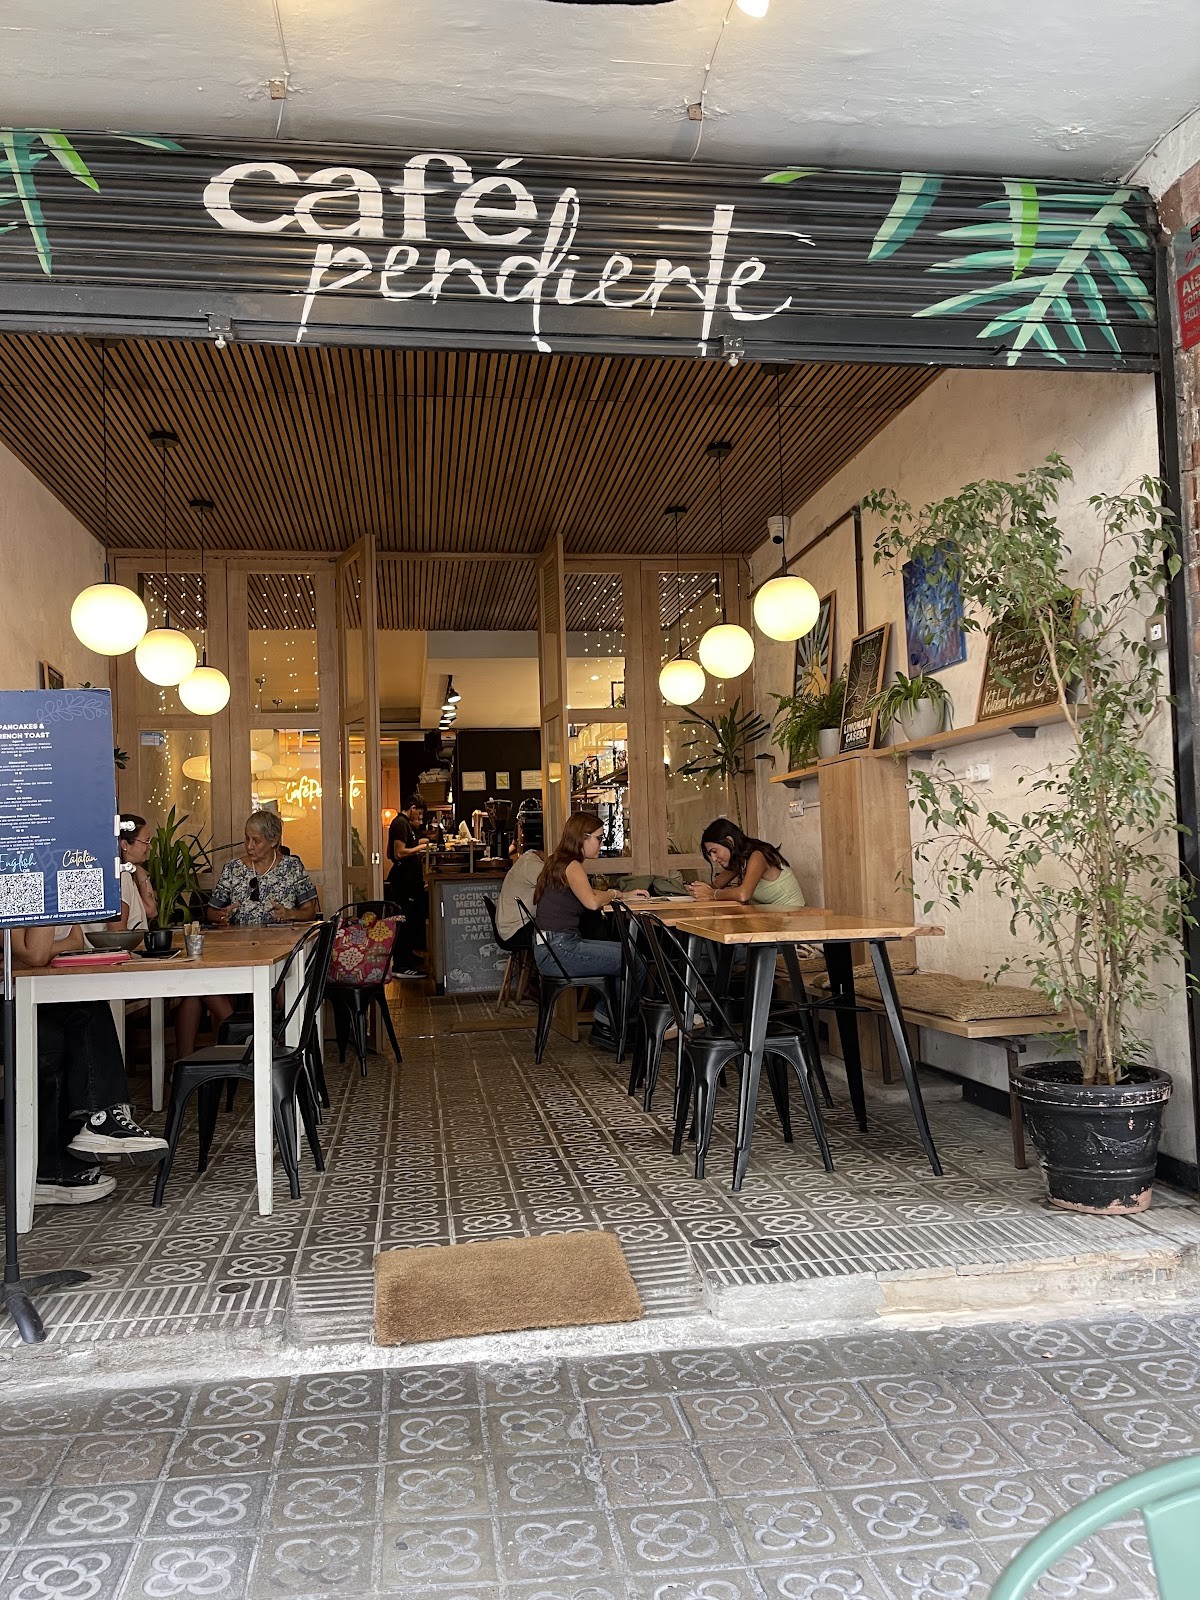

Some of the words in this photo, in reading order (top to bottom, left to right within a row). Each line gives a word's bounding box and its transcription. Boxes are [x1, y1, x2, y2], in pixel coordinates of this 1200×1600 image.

[203, 154, 538, 244] café
[291, 187, 816, 357] pendiente
[845, 728, 867, 743] CASERA
[459, 908, 490, 916] BRUN
[451, 916, 491, 924] DESAYU
